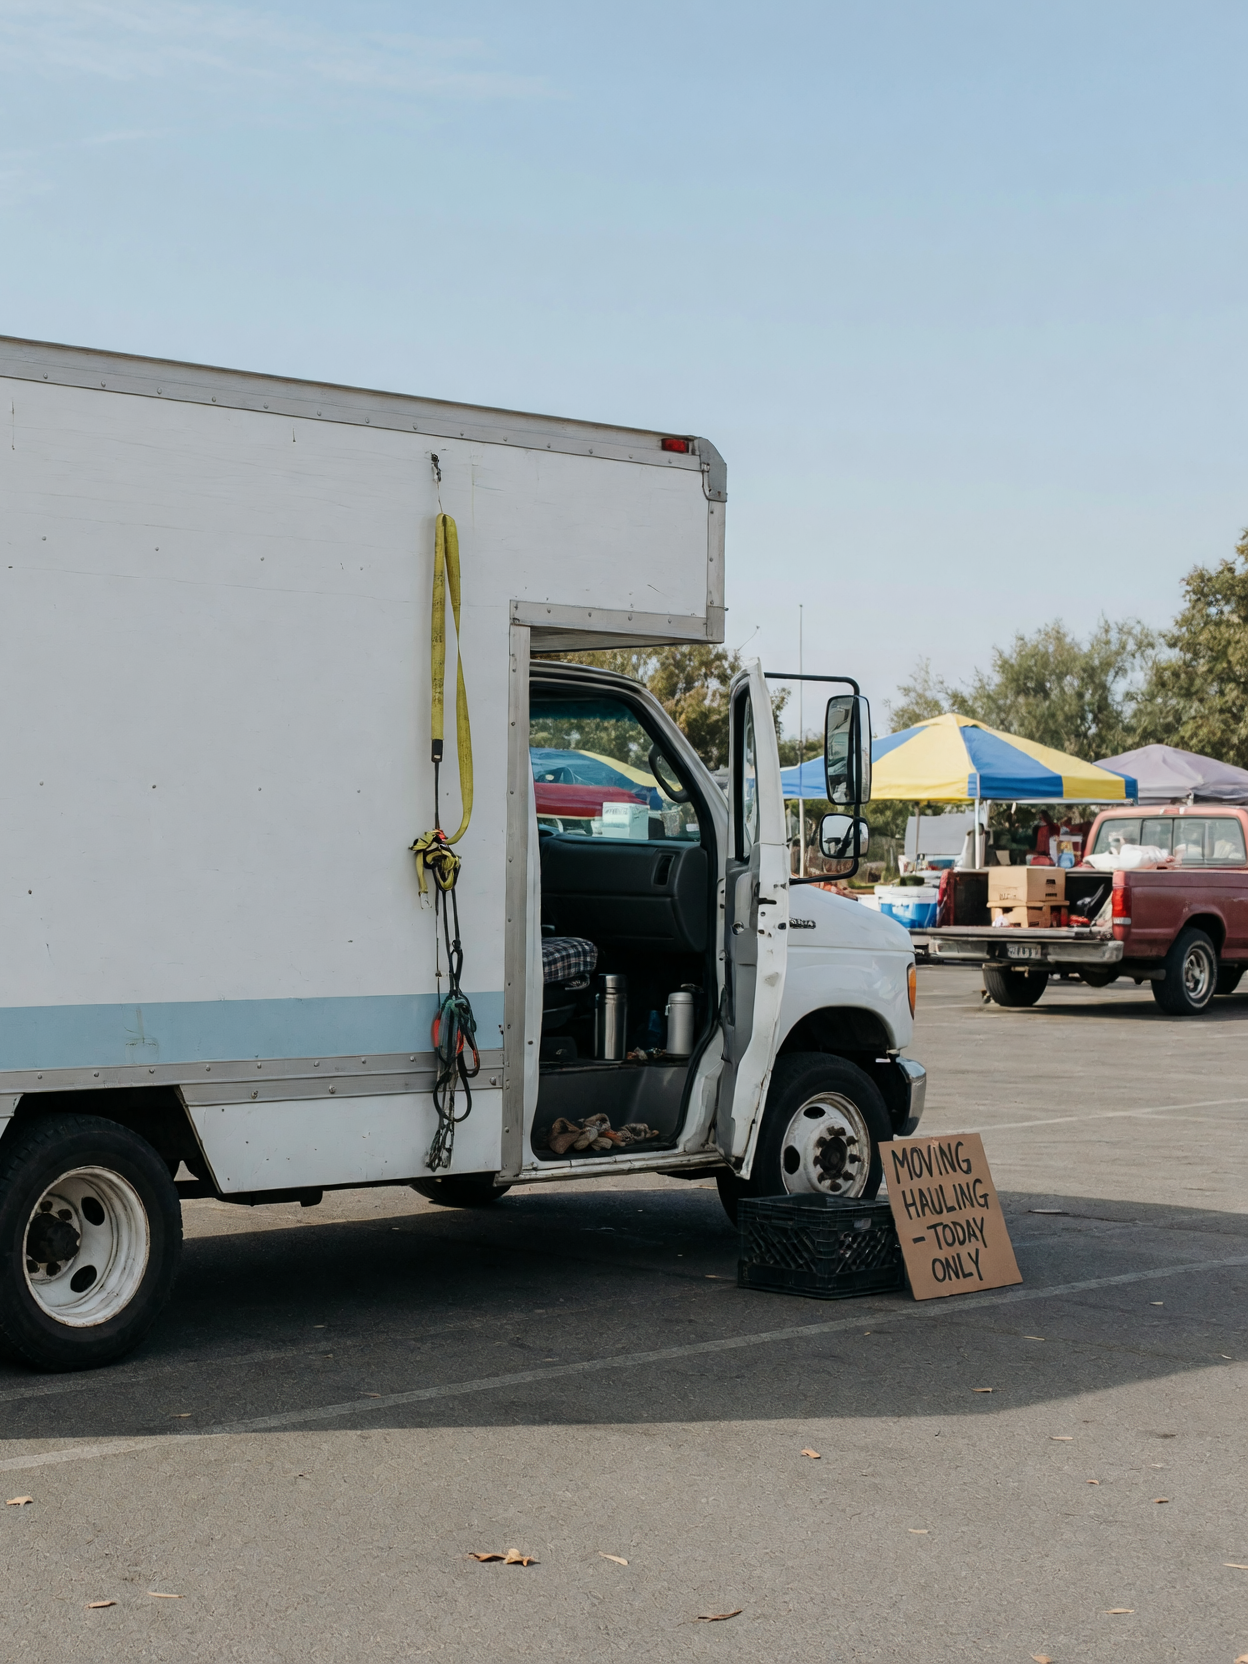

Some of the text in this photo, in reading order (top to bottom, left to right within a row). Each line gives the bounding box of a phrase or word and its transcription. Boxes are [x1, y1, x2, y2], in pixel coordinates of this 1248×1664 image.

[891, 1141, 972, 1184] MOVING
[902, 1178, 989, 1220] HAULING
[931, 1248, 984, 1283] ONLY
